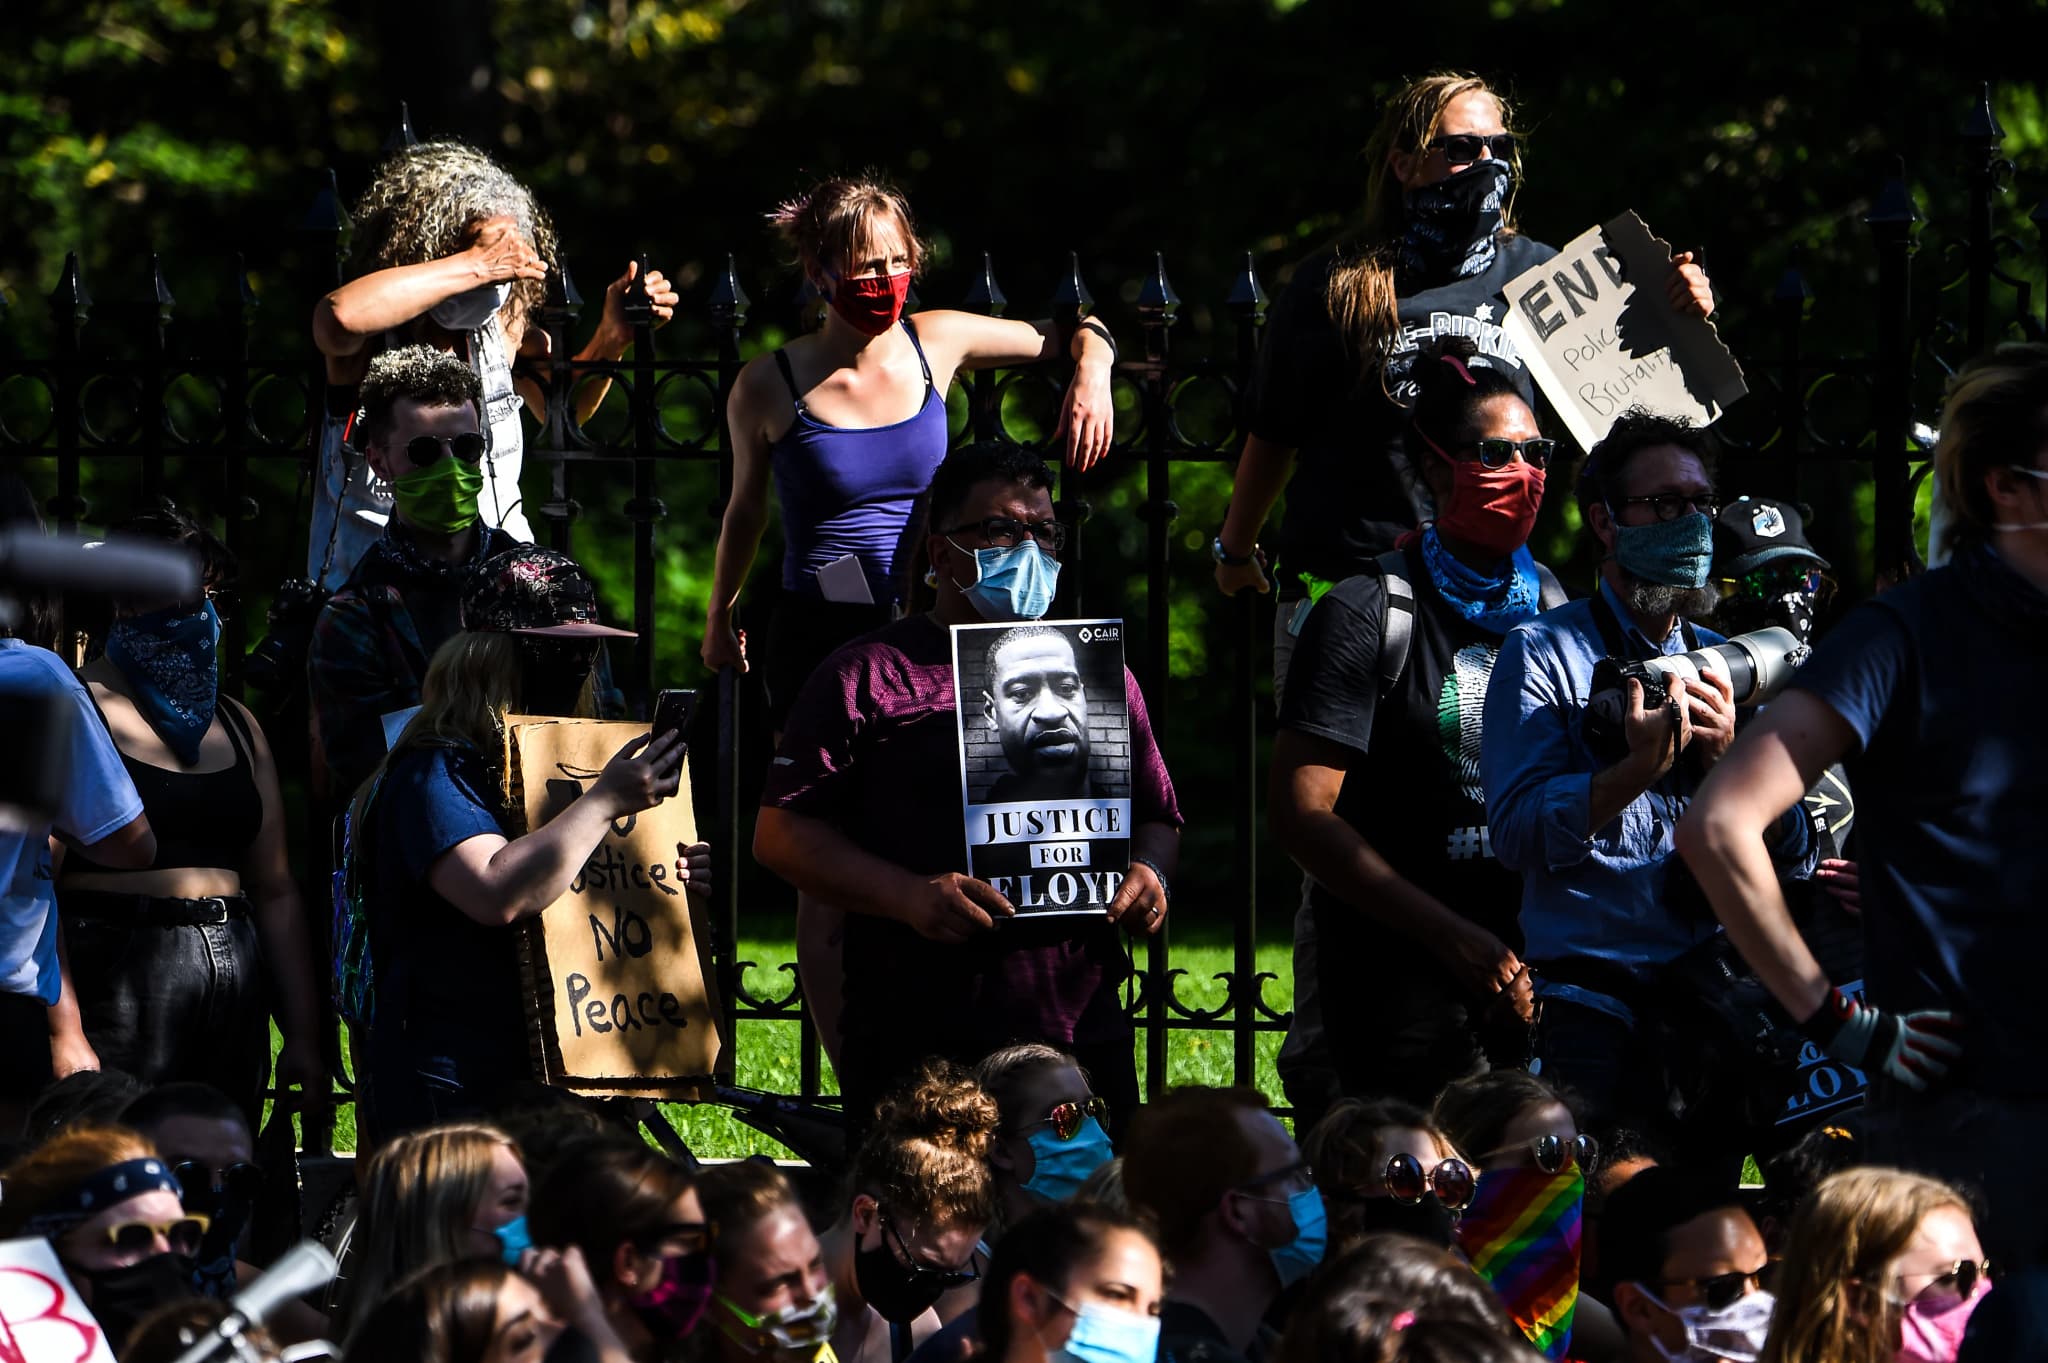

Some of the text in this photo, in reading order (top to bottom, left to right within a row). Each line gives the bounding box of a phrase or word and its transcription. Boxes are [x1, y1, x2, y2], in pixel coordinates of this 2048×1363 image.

[1093, 628, 1119, 638] CAIR
[983, 807, 1121, 844] JUSTICE
[569, 844, 679, 895] ustice
[1039, 846, 1083, 865] FOR
[589, 905, 653, 961] NO
[565, 972, 687, 1037] Peace
